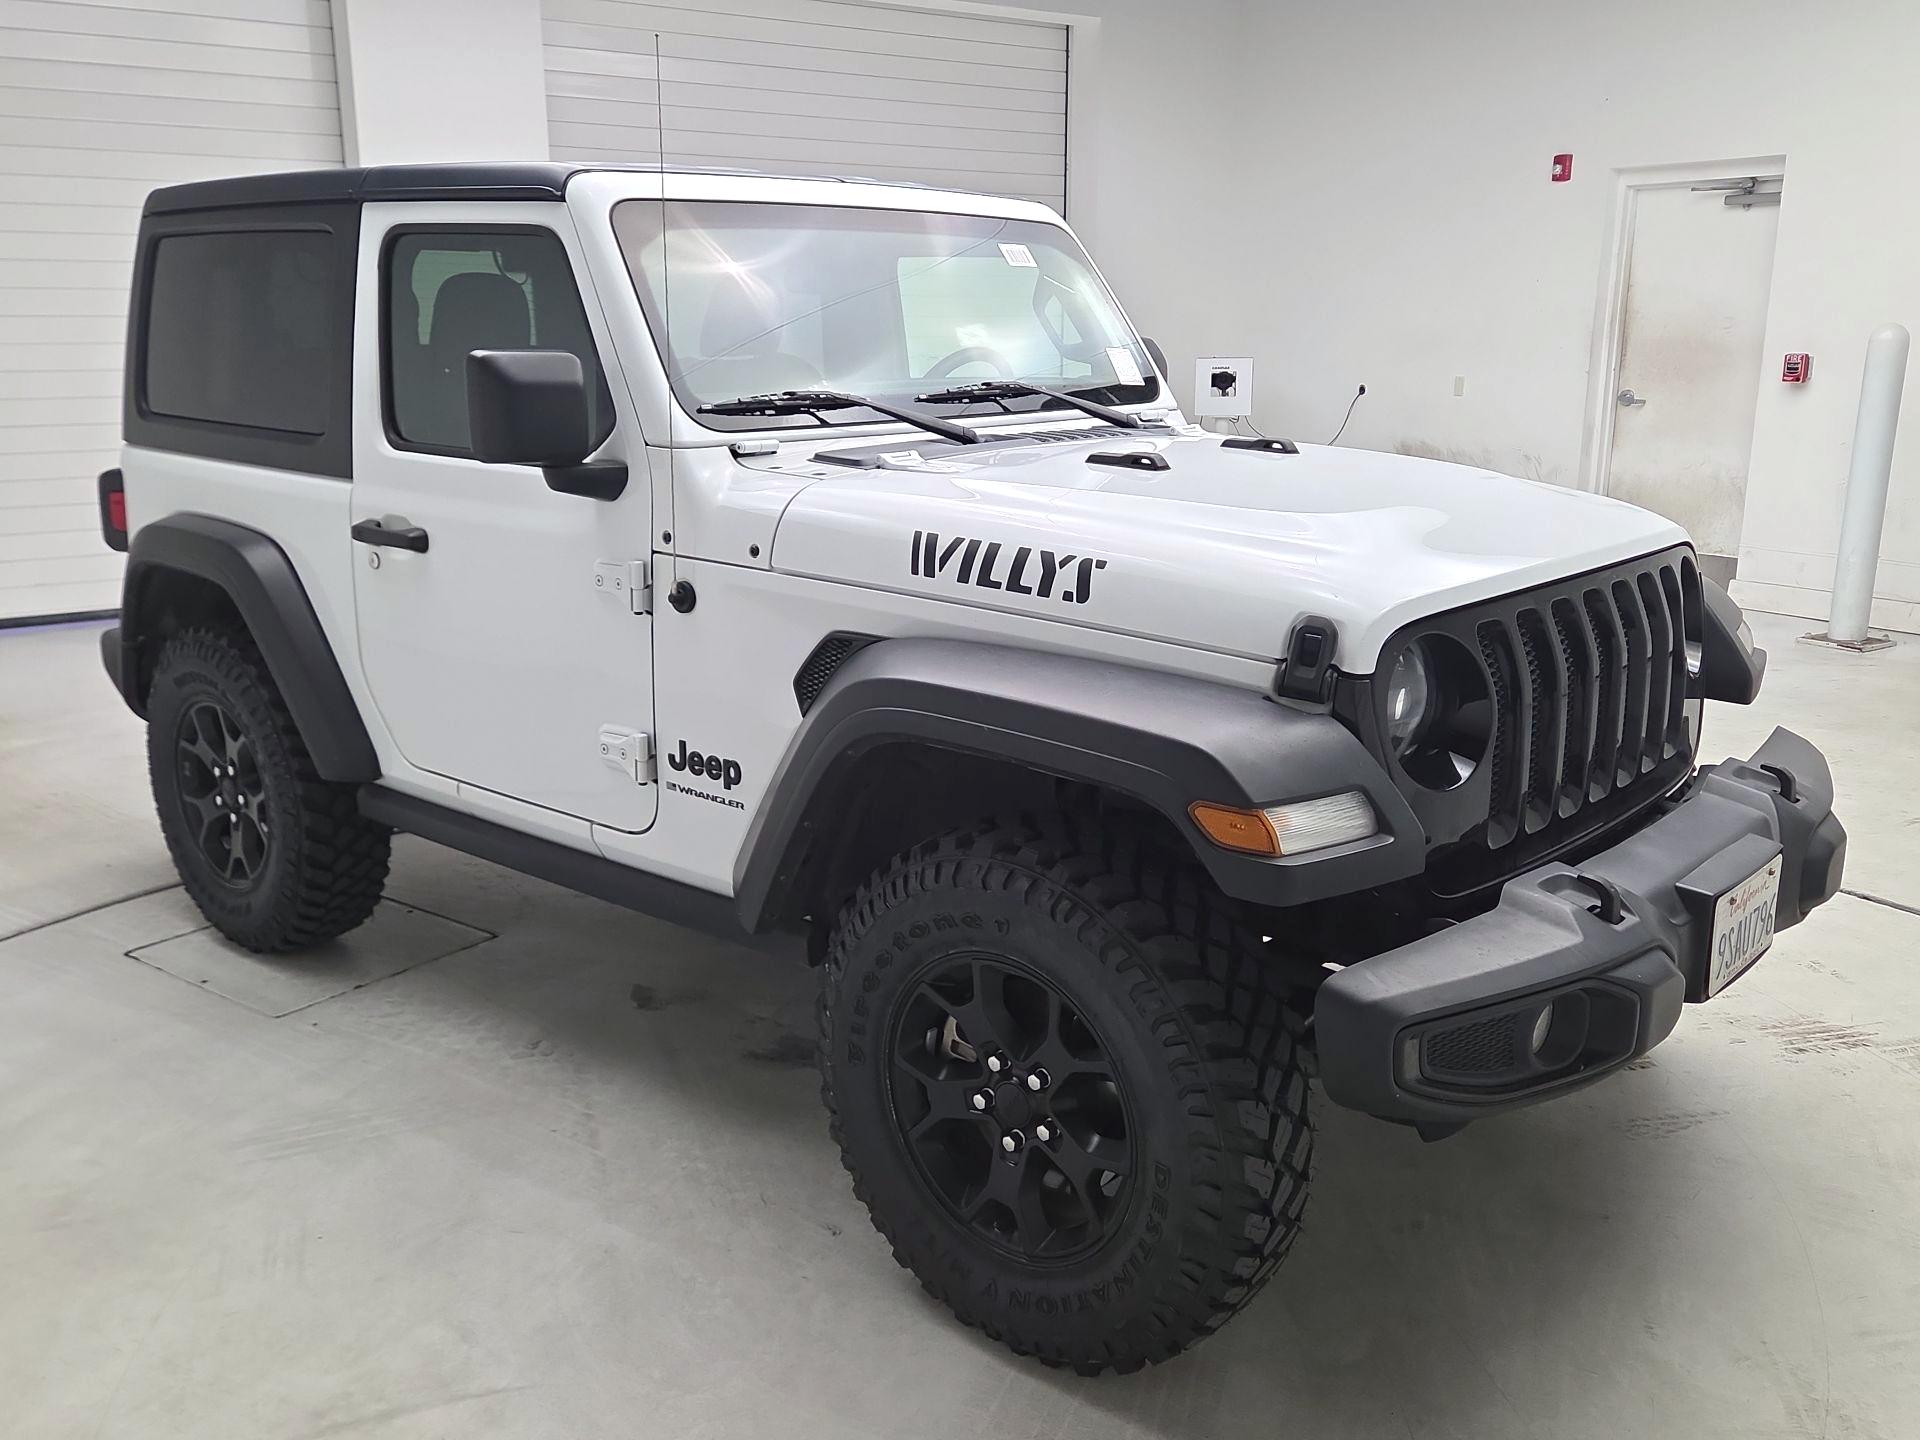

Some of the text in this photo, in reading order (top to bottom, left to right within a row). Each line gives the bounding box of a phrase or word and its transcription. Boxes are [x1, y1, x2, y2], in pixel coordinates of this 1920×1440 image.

[1786, 354, 1803, 362] FIRE
[911, 530, 1108, 604] WILLYS
[667, 739, 742, 791] Jeep
[676, 783, 745, 810] WRANGLER
[1715, 891, 1777, 981] 9SAU796
[1008, 1160, 1173, 1315] DESTINATION
